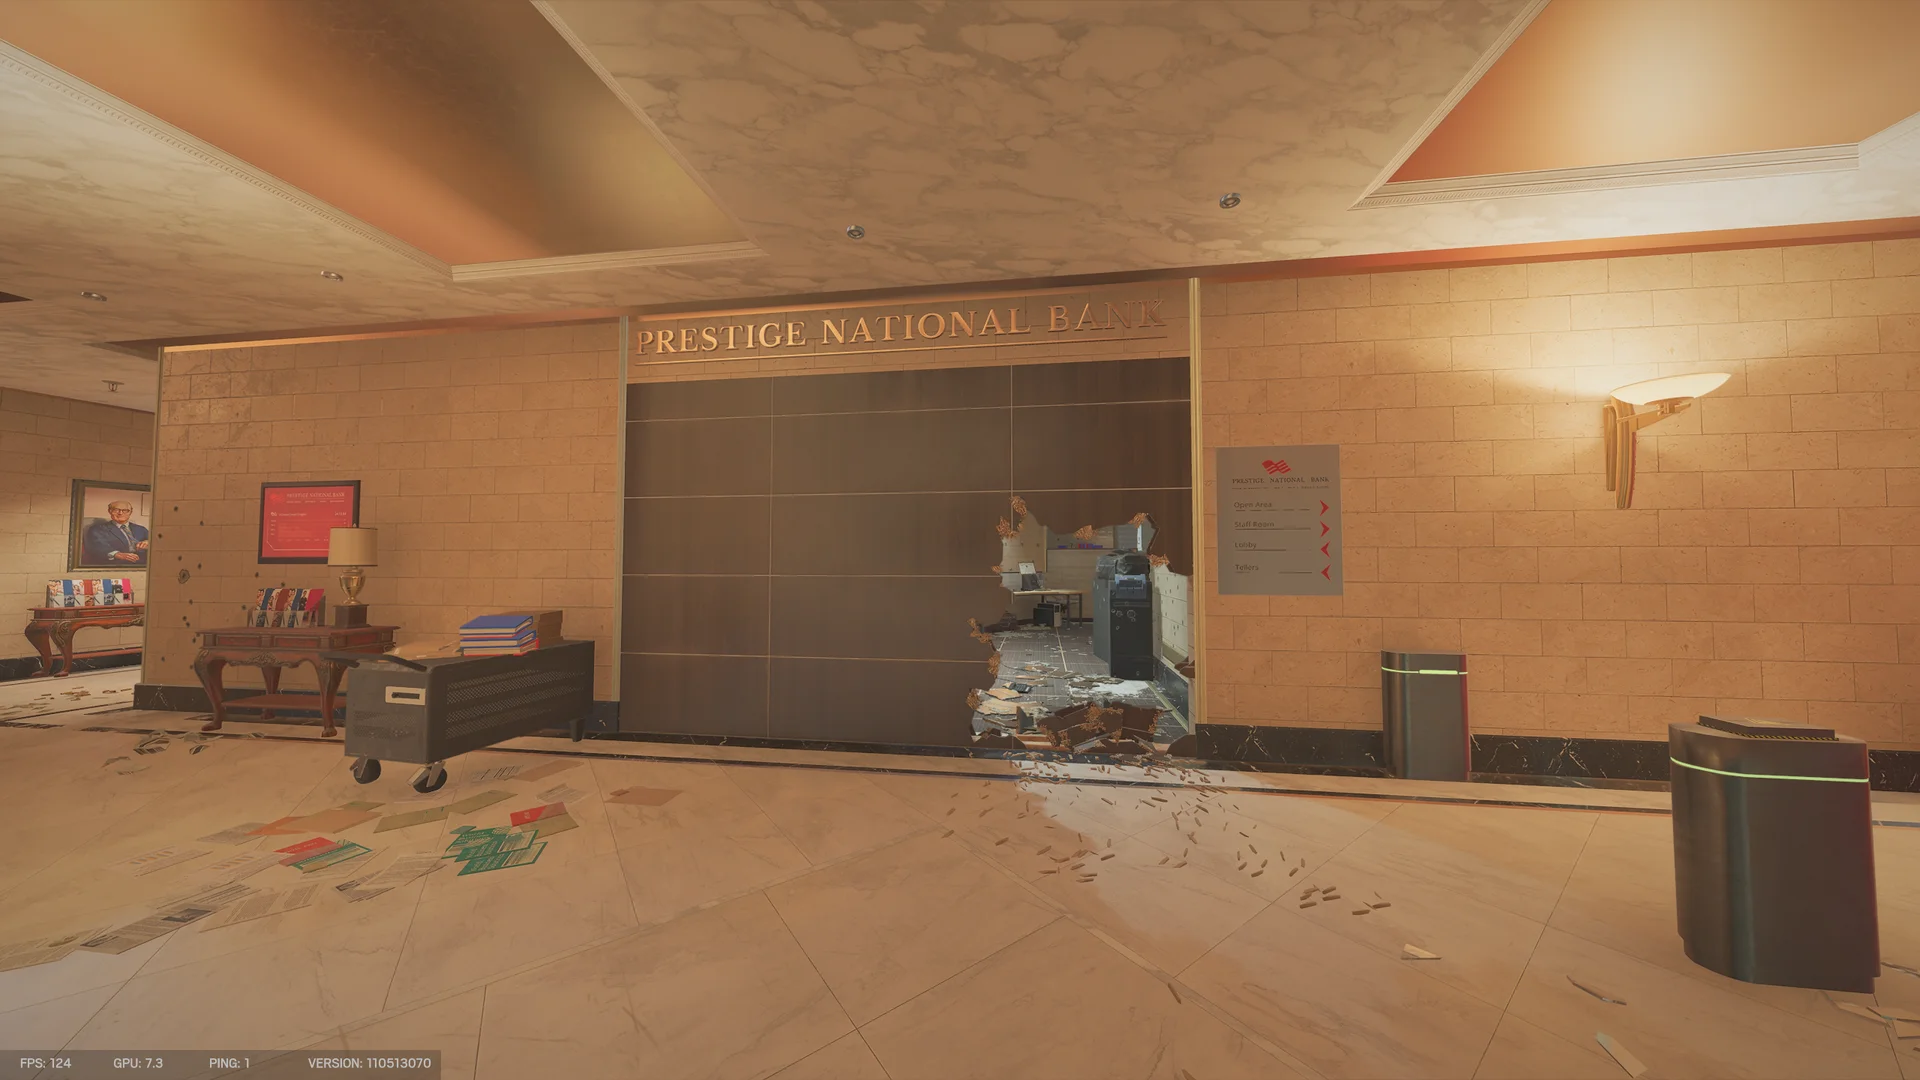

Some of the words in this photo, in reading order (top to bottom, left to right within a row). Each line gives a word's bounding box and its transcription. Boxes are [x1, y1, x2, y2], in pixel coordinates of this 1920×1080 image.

[636, 321, 807, 355] PRESTIGE
[821, 308, 1031, 345] NATIONAL
[1047, 299, 1166, 333] BANK
